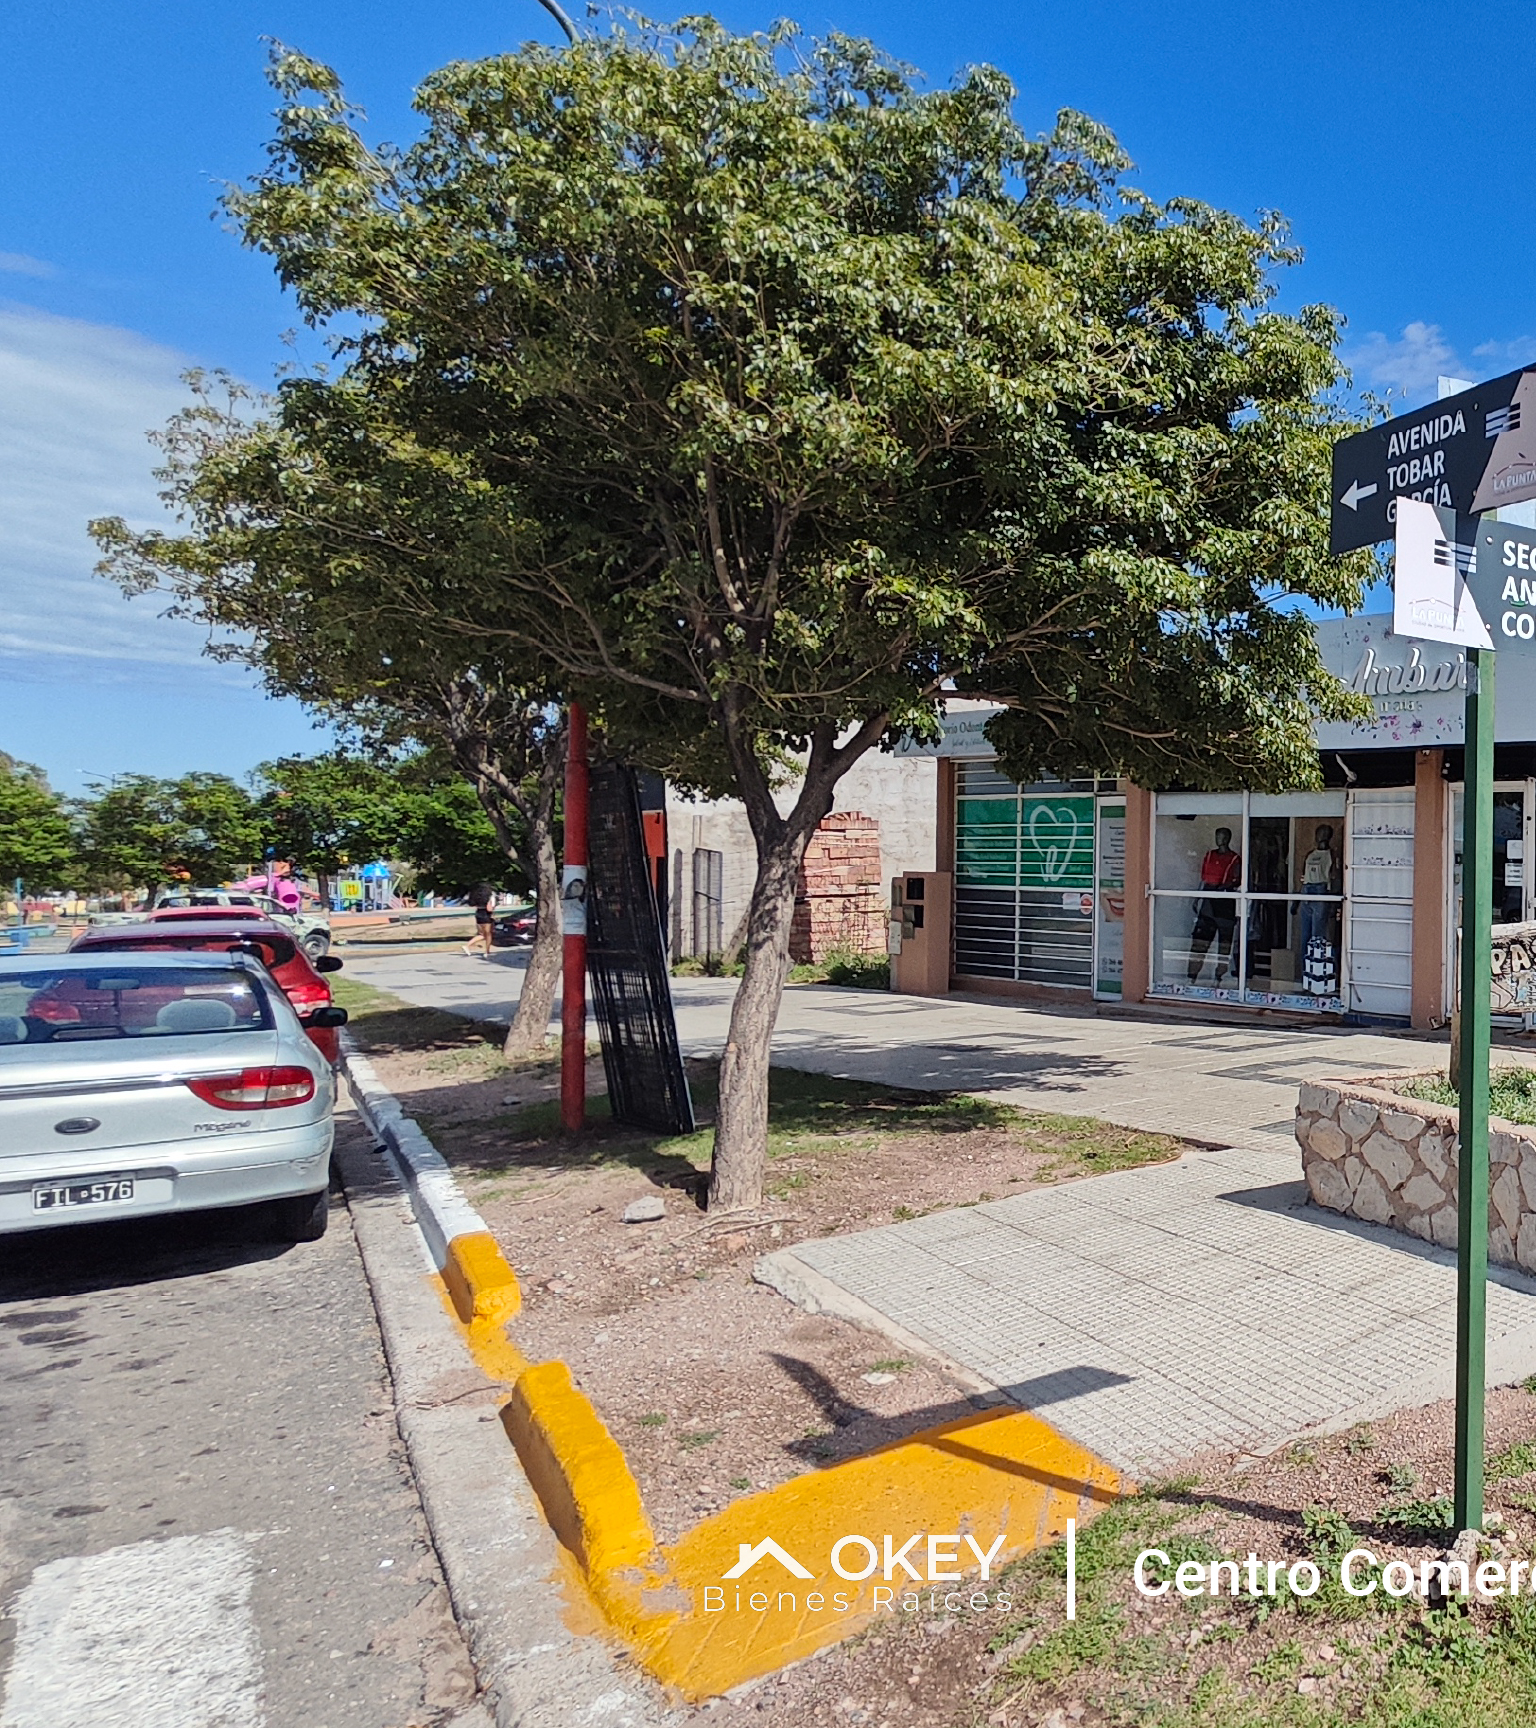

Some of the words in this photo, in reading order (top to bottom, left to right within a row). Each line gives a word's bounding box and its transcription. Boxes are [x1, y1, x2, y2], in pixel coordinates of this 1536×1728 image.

[1387, 409, 1466, 460] AVENIDA
[1387, 449, 1445, 492] TOBAR
[1507, 470, 1536, 488] PUNTA
[1428, 609, 1465, 628] PUNA
[36, 1188, 77, 1208] FIL
[91, 1181, 131, 1202] 576
